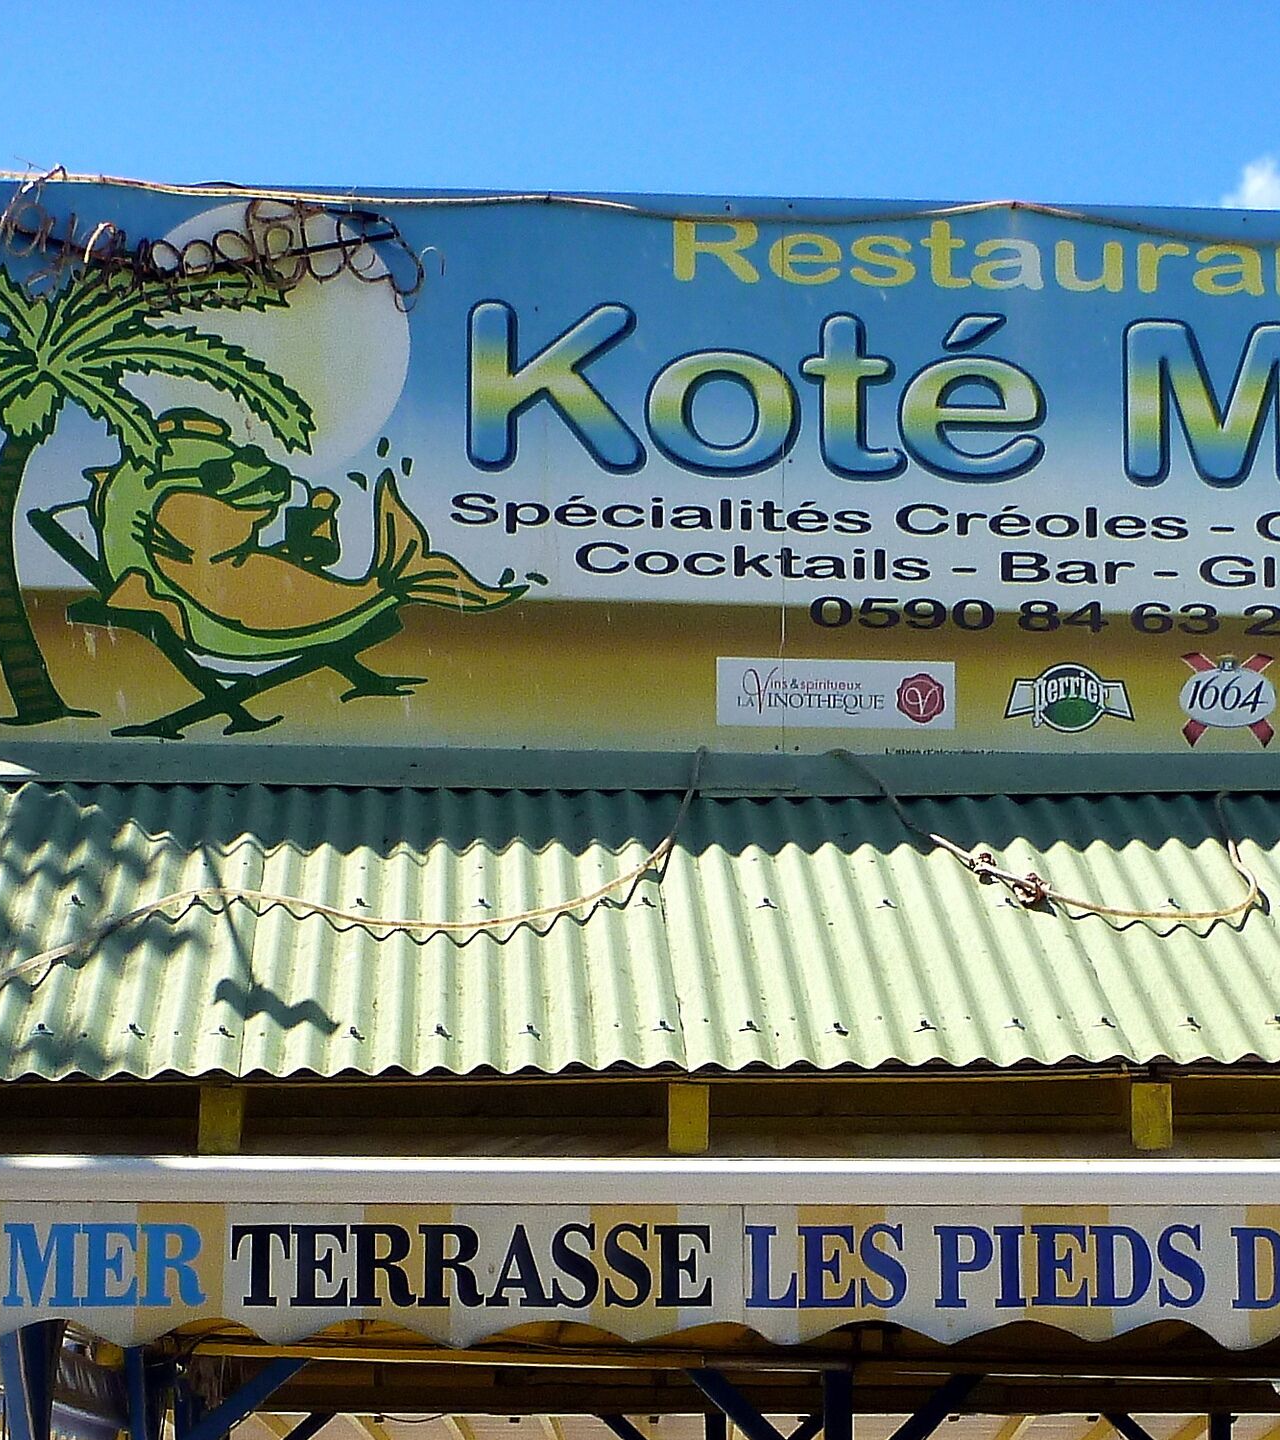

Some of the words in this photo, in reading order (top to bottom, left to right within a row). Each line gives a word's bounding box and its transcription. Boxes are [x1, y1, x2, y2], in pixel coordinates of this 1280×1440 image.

[466, 299, 1047, 484] Koté
[450, 493, 872, 535] Spécialités
[895, 502, 1189, 541] Créoles
[575, 543, 931, 581] Cocktails
[1000, 551, 1134, 585] Bar
[810, 596, 995, 632] 0590
[1018, 600, 1108, 634] 84
[1130, 602, 1219, 636] 63
[1188, 674, 1268, 714] 1664
[3, 1222, 207, 1308] MER
[231, 1222, 712, 1308] TERRASSE
[745, 1223, 908, 1309] LES
[934, 1223, 1206, 1309] PIEDS
